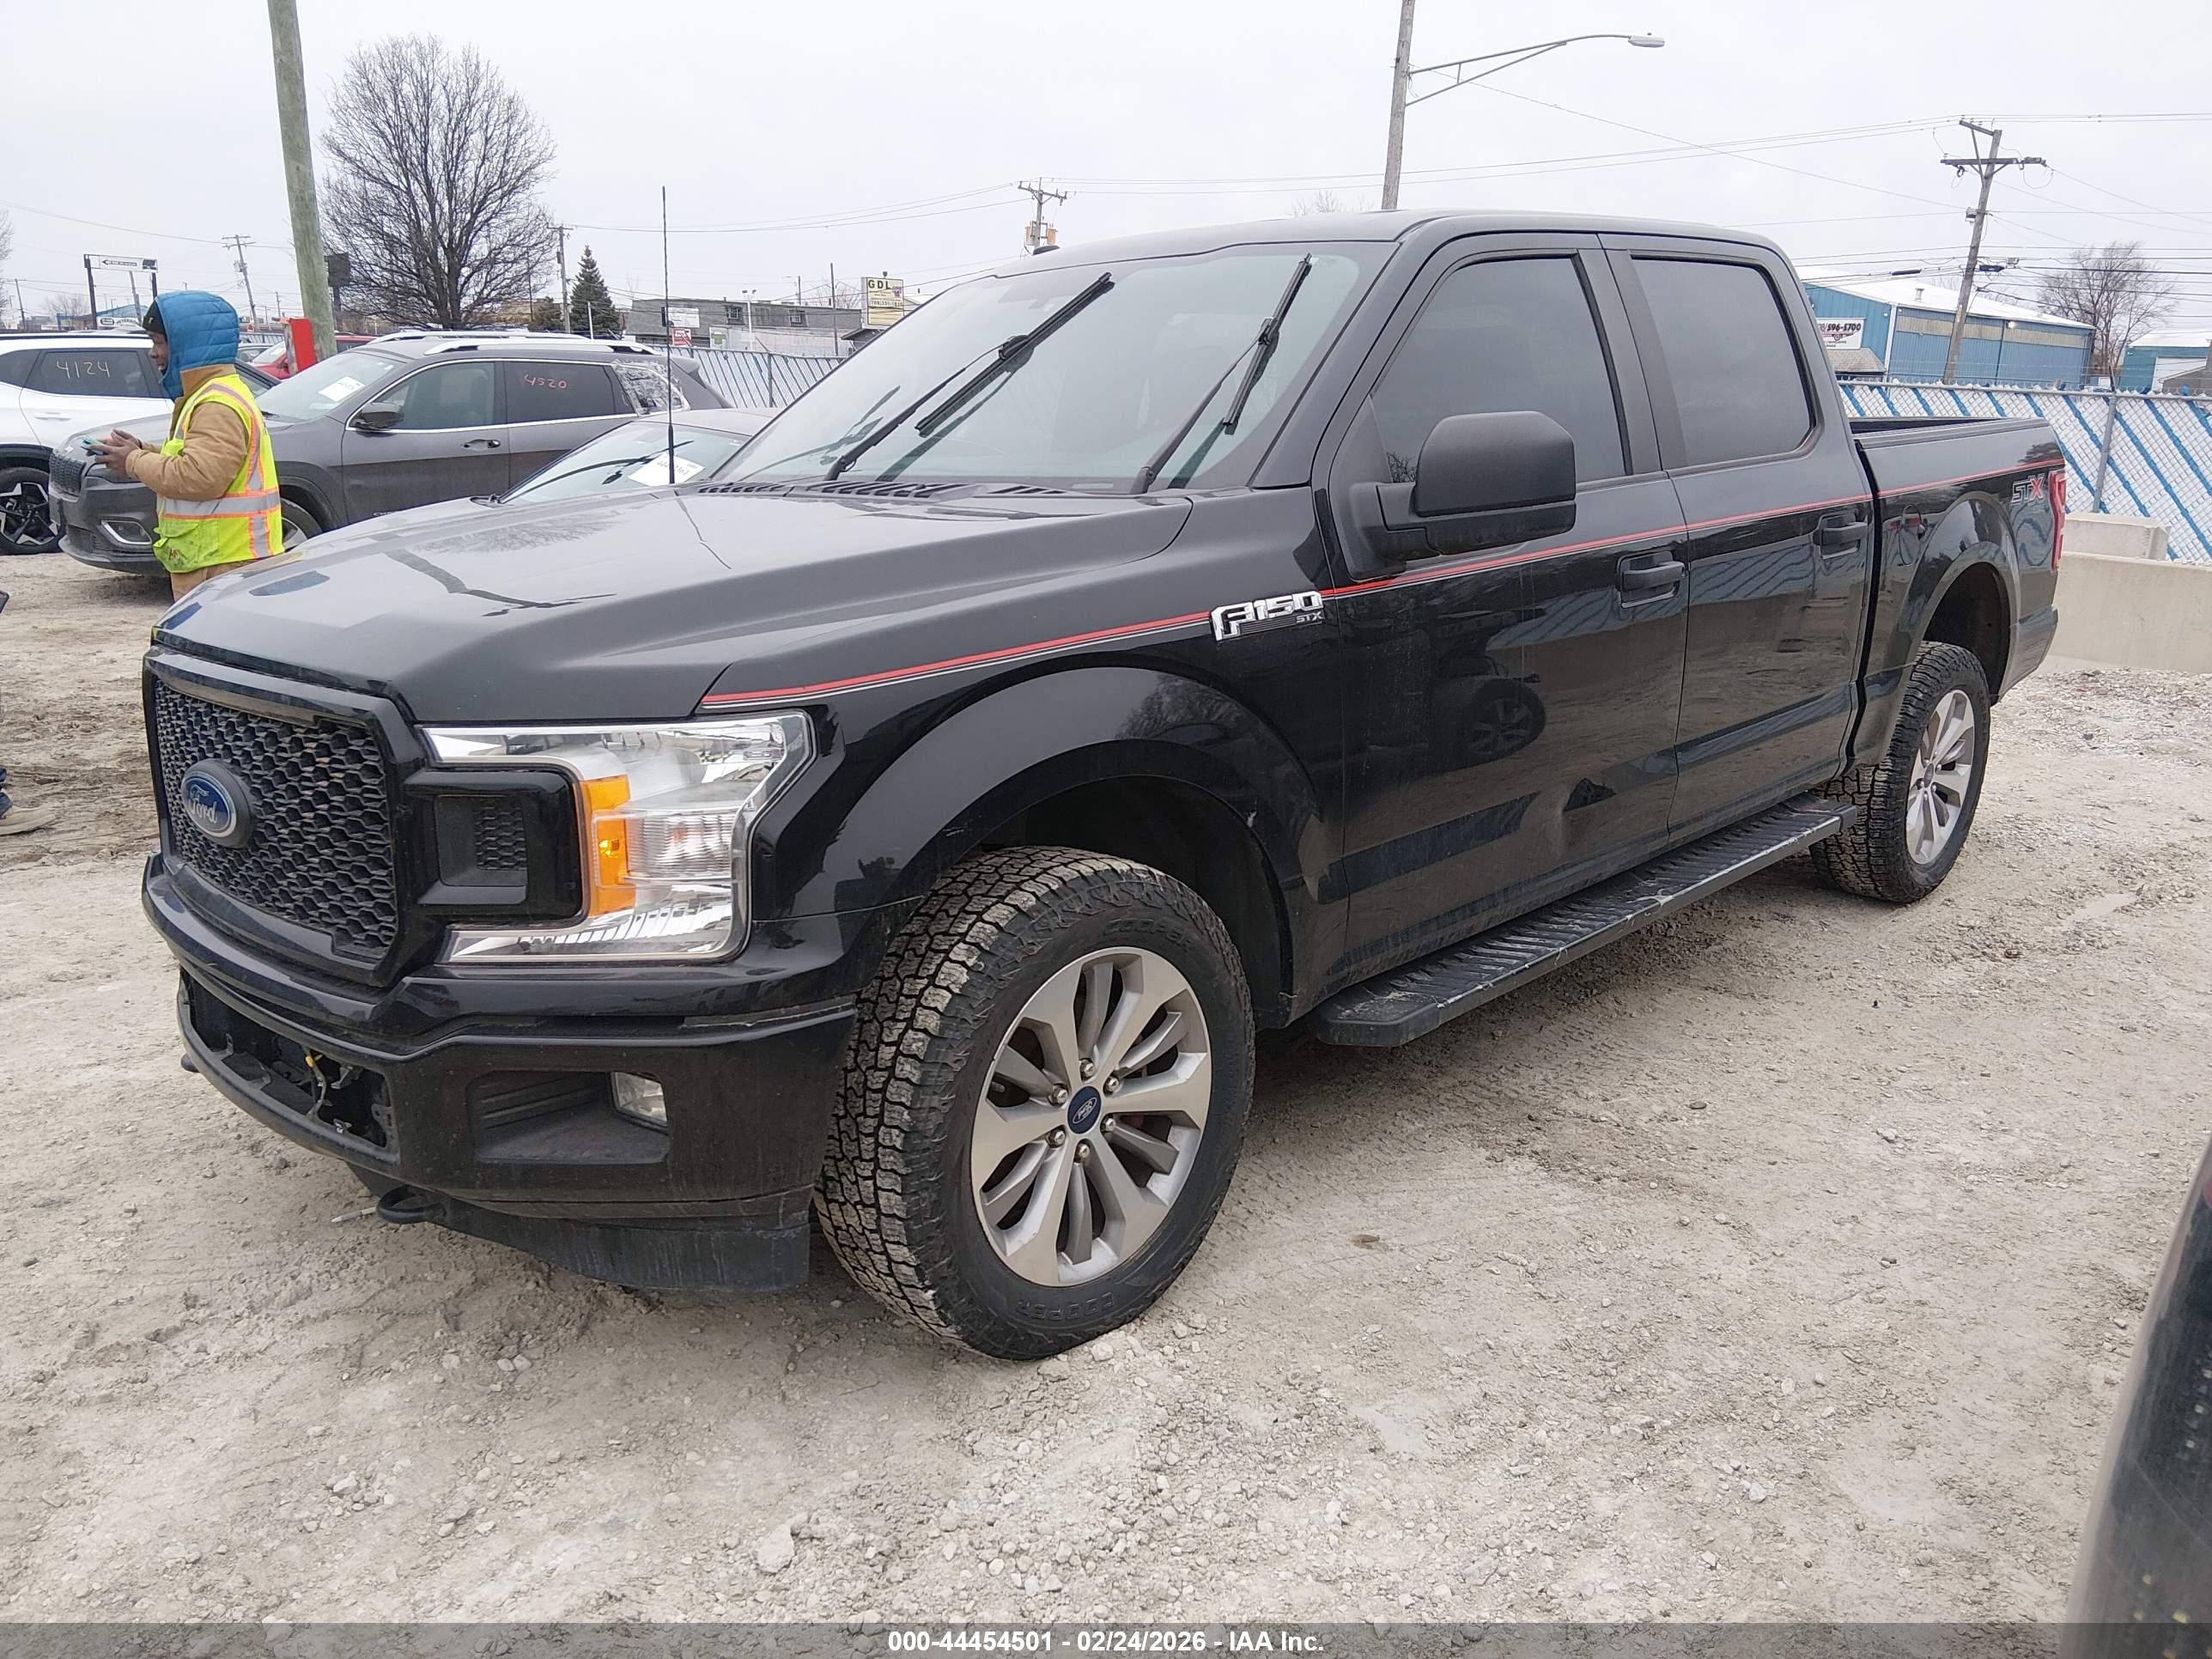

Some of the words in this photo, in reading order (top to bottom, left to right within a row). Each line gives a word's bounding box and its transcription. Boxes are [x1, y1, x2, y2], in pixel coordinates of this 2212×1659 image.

[57, 361, 110, 378] 4124
[524, 374, 567, 389] 4520
[2011, 473, 2045, 505] STX
[1296, 611, 1323, 623] STX
[188, 784, 219, 824] Ford
